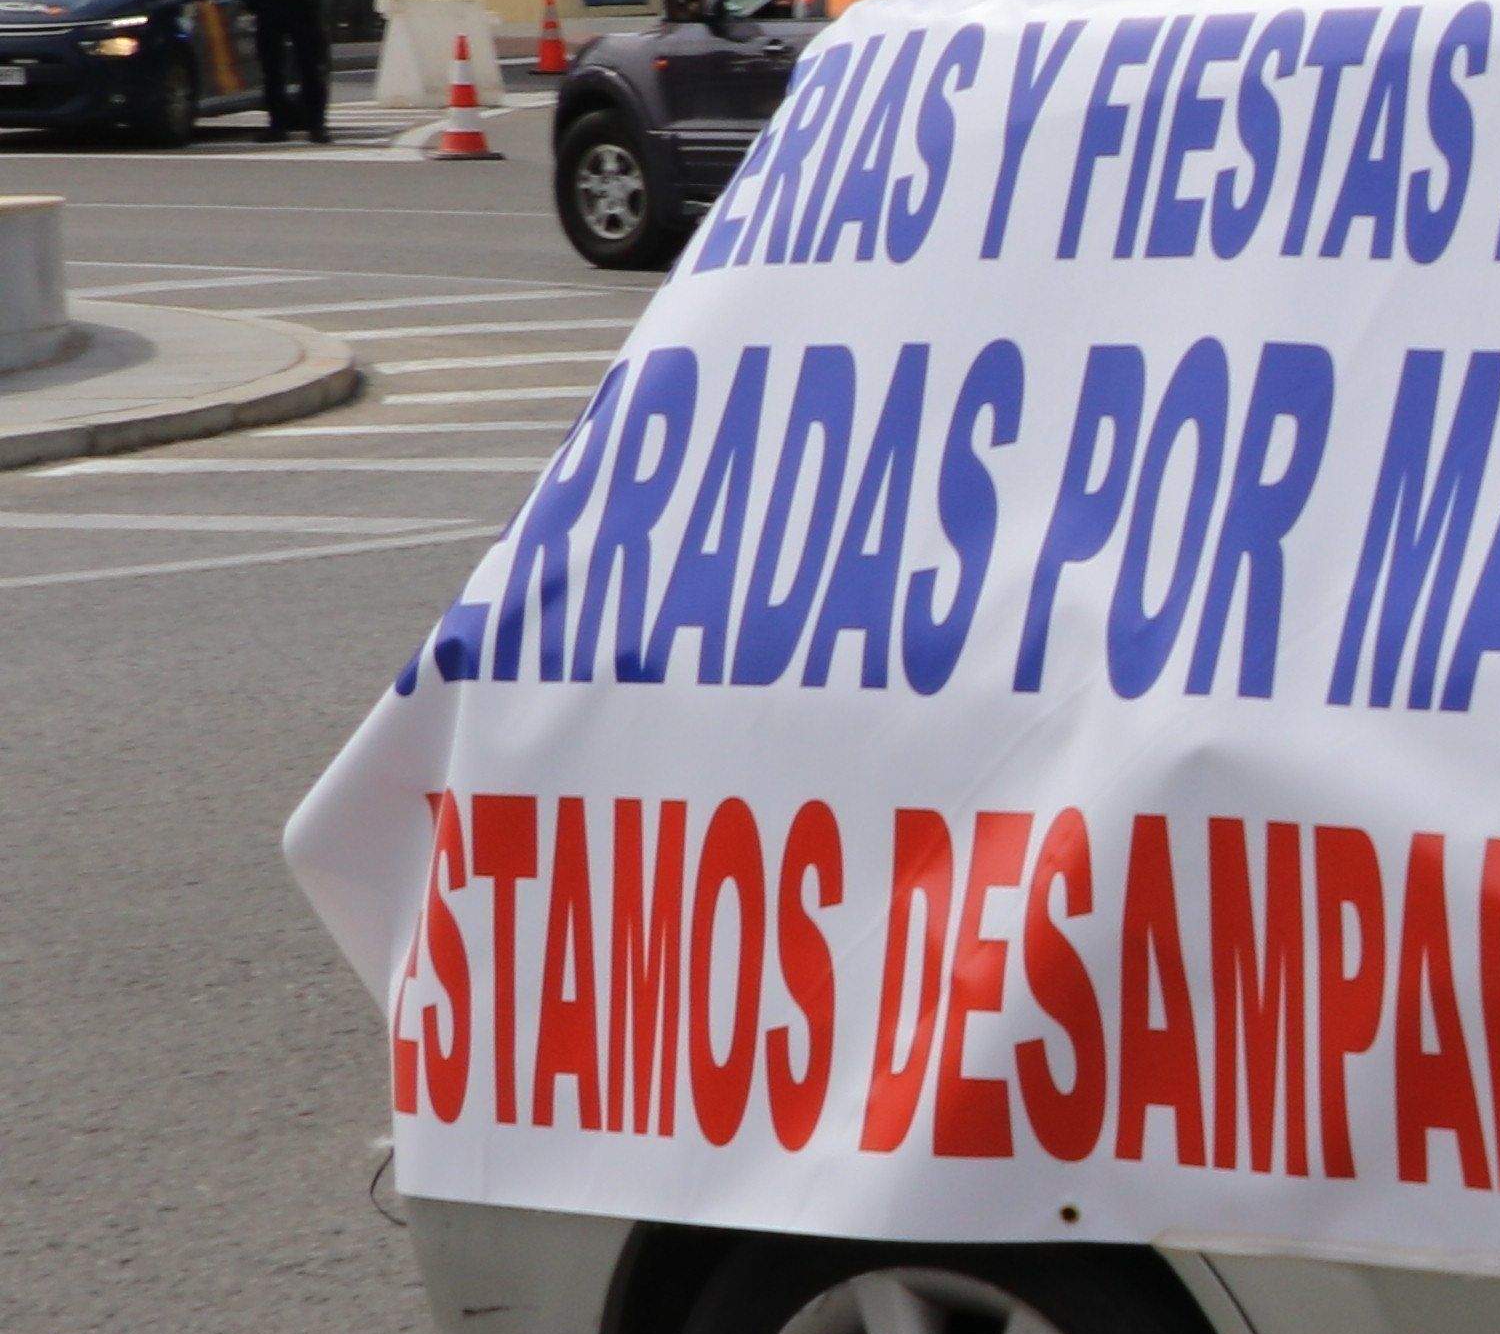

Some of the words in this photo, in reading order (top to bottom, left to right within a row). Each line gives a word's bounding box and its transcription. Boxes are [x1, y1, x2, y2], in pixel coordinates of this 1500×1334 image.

[978, 19, 1088, 260] Y
[1056, 4, 1494, 263] FIESTAS
[1011, 335, 1336, 700] POR
